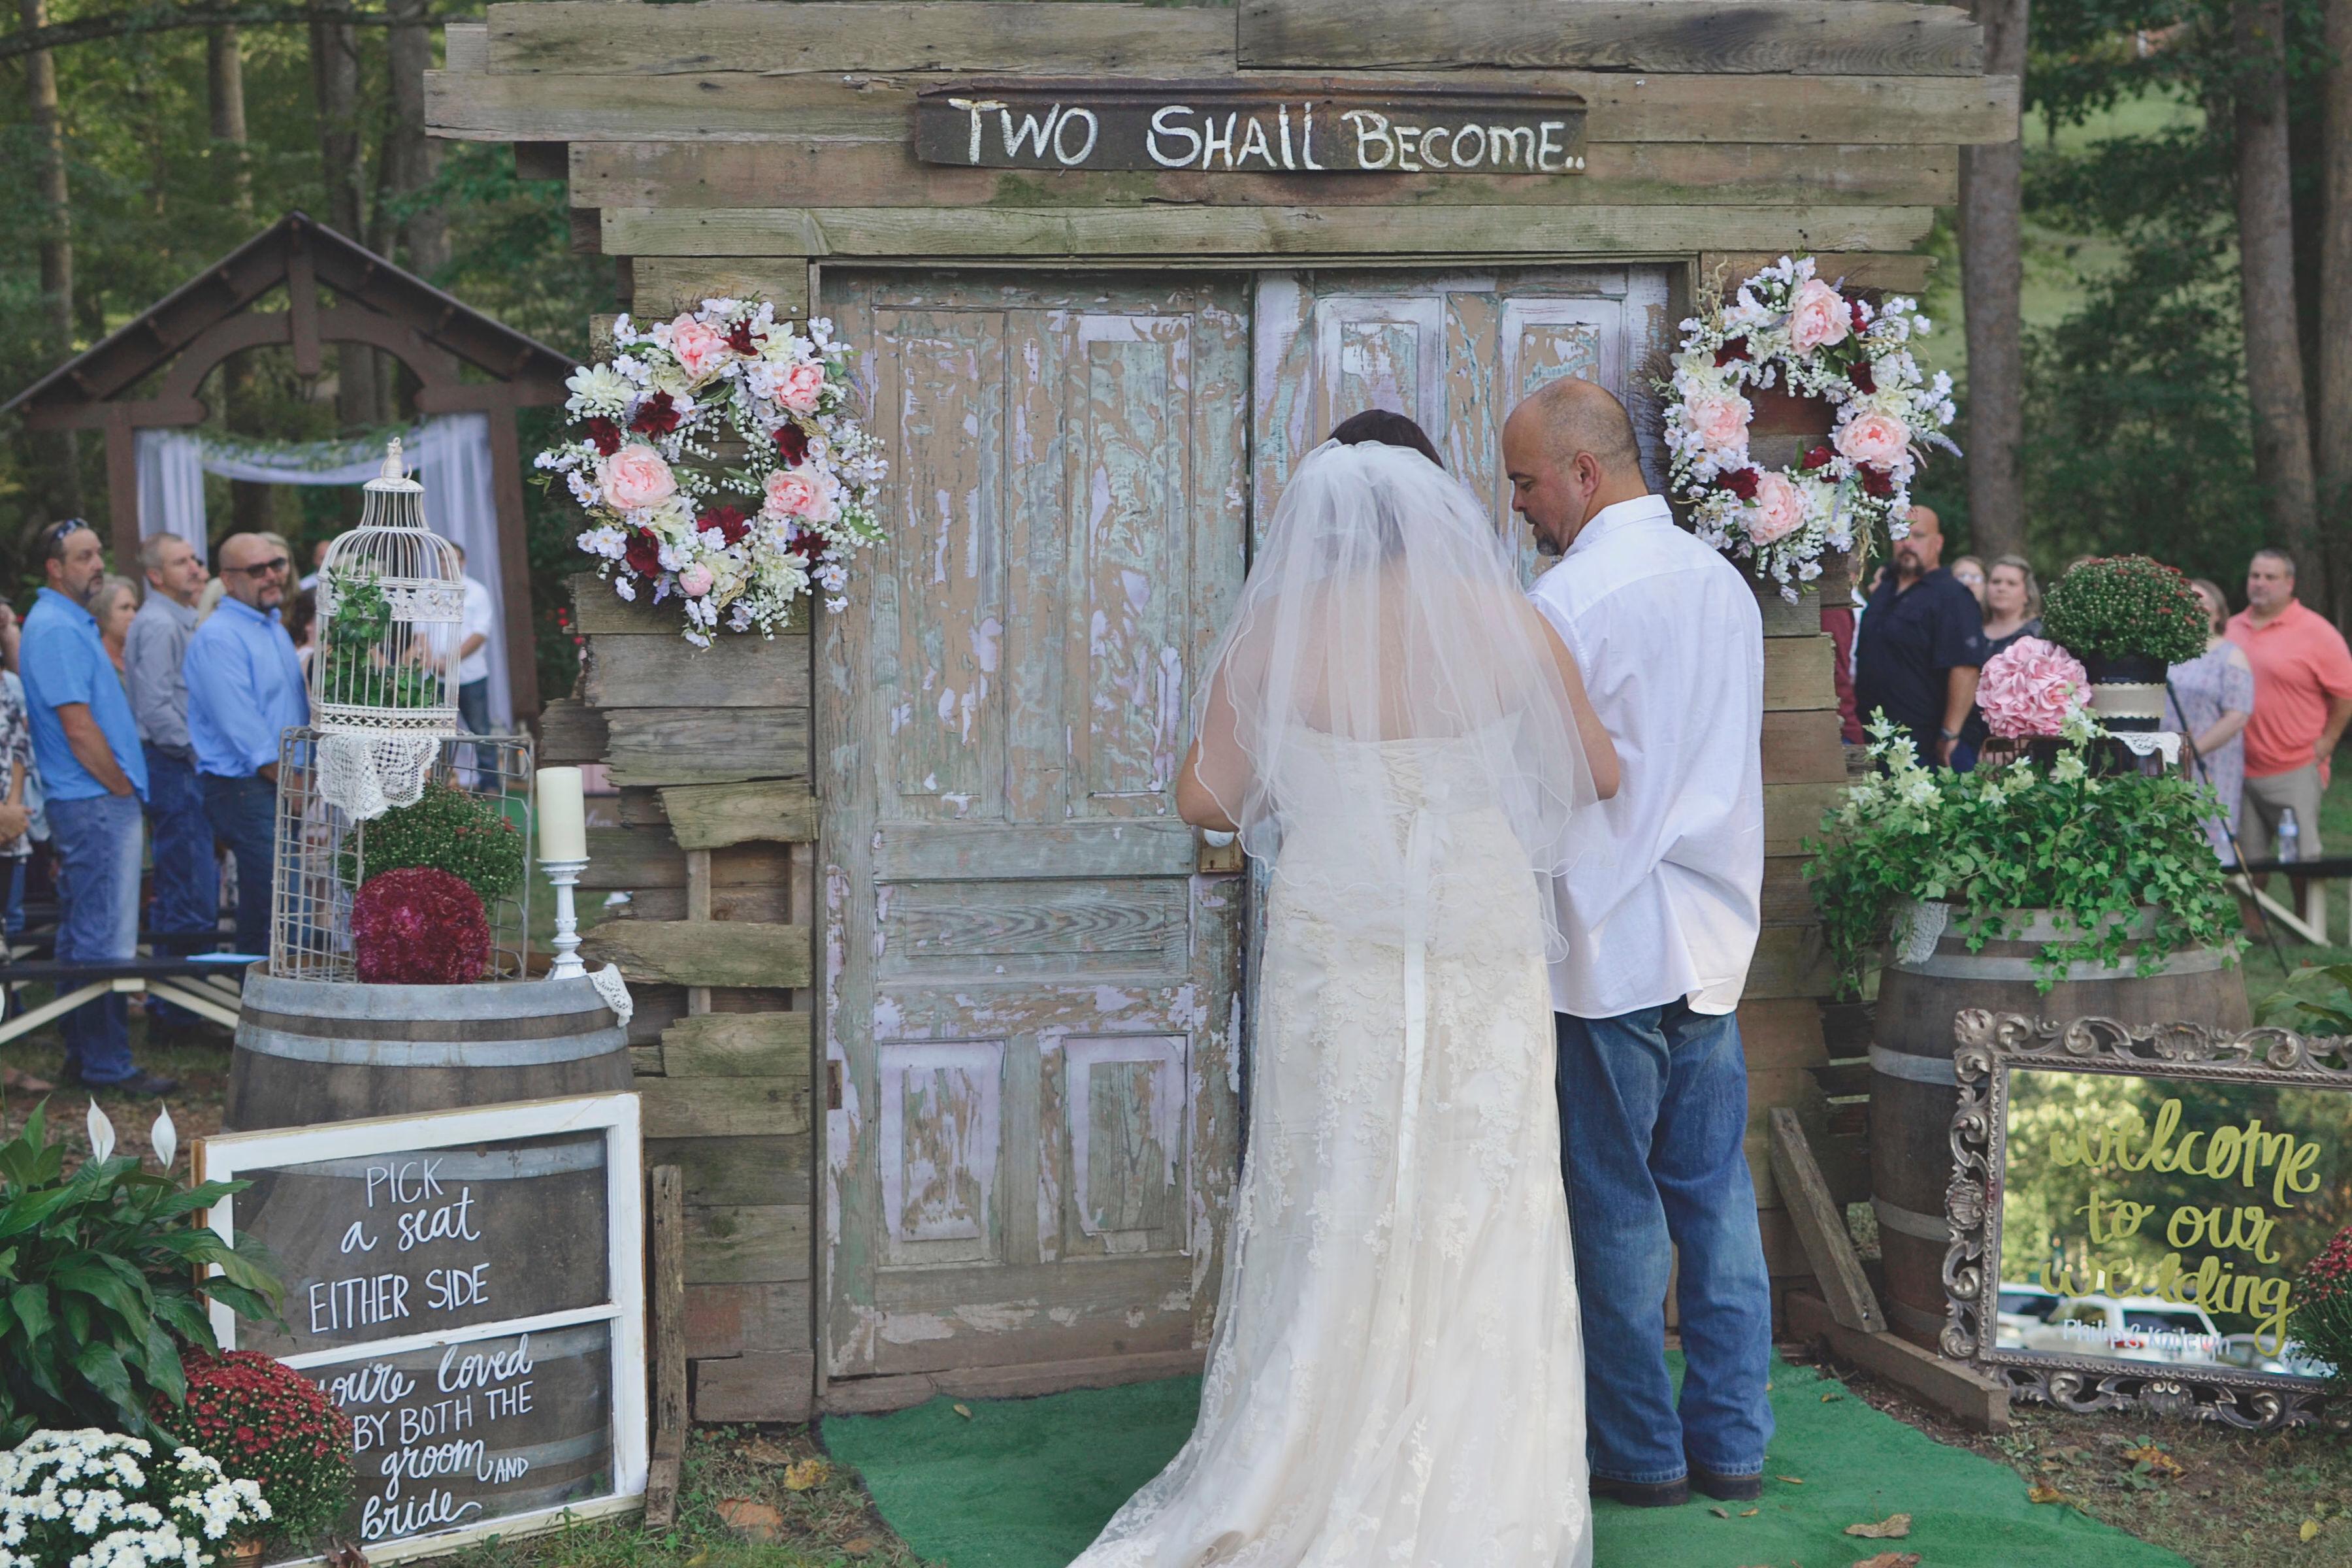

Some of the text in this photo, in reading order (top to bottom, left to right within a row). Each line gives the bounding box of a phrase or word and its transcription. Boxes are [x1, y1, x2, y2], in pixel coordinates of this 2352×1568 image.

[949, 98, 1098, 165] TWO
[366, 1158, 443, 1207] PICK
[2049, 1098, 2321, 1209] welcome
[340, 1186, 481, 1254] a seat
[2074, 1189, 2280, 1264] to our
[309, 1262, 491, 1333] EITHER SIDE
[2039, 1252, 2300, 1358] wedding
[317, 1334, 534, 1409] ou're loved
[353, 1380, 534, 1453] BY BOTH THE
[380, 1439, 529, 1501] groom AND
[361, 1488, 483, 1541] bride
